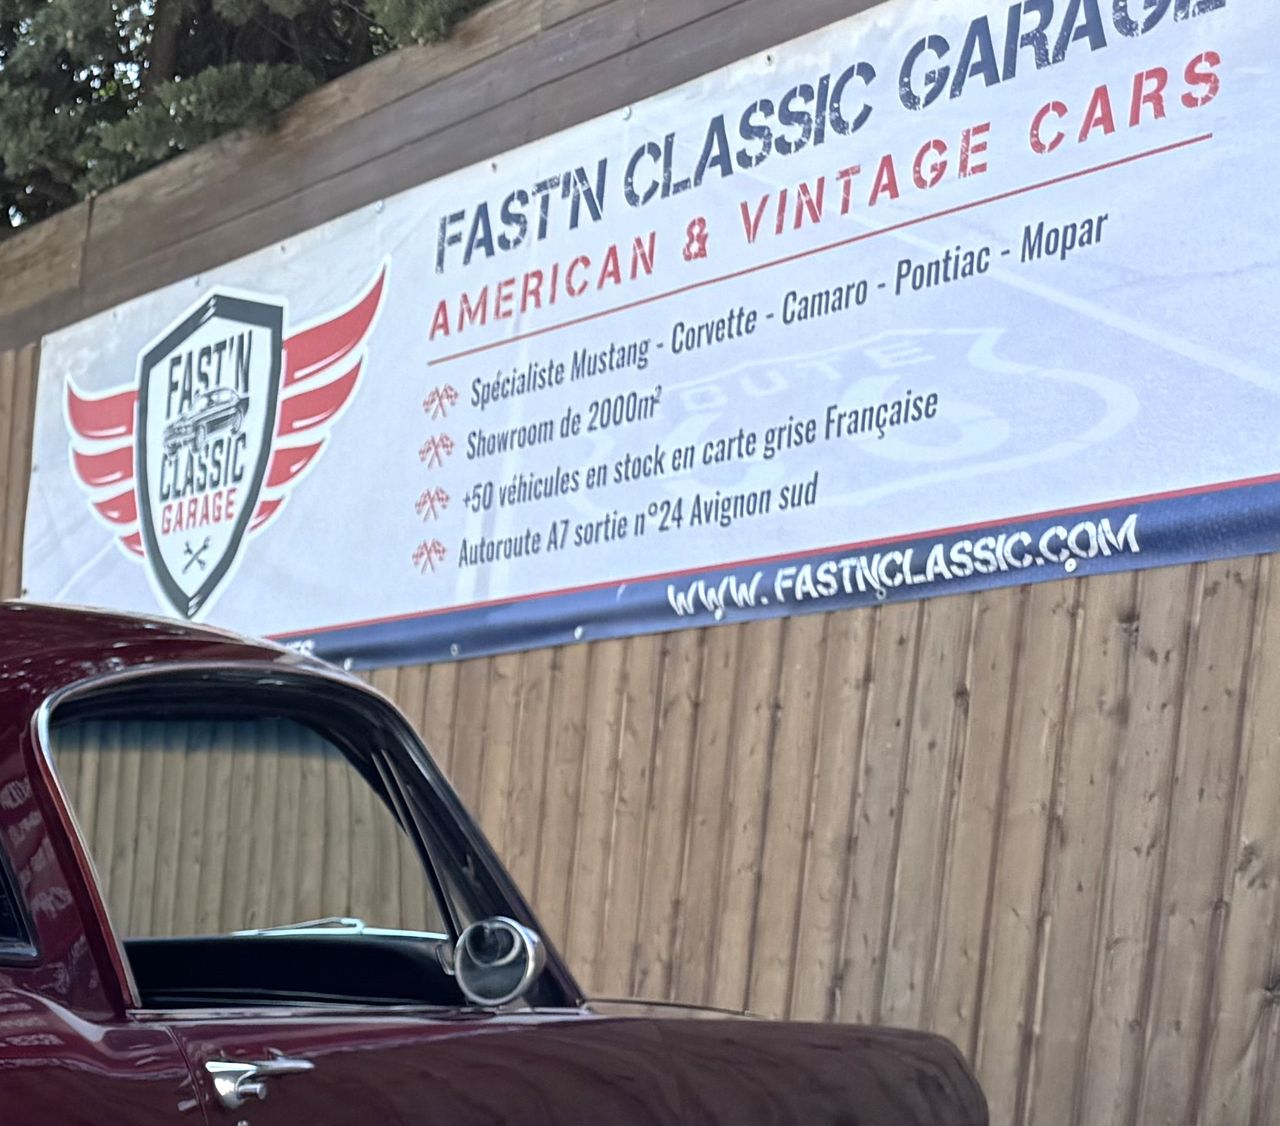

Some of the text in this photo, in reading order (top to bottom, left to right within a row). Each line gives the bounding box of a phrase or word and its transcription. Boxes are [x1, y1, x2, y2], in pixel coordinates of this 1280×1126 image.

[429, 51, 1221, 341] AMERICAN & VINTAGE CARS
[435, 157, 607, 274] FAST'N
[624, 62, 876, 207] CLASSIC
[471, 359, 565, 410] Spécialiste
[571, 338, 651, 382] Mustang
[671, 307, 758, 354] Corvette
[782, 278, 868, 325] Camaro
[877, 282, 886, 290] -
[895, 245, 991, 297] Pontiac
[1001, 248, 1011, 256] -
[1021, 213, 1109, 263] Mopar
[166, 329, 252, 420] FAST'N
[466, 385, 662, 460] Showroom de 2000m²
[160, 432, 247, 504] CLASSIC
[462, 389, 938, 513] +50 véhicules en stock en carte grise Française
[162, 488, 237, 534] GARAGE
[458, 471, 819, 567] Autoroute A7 sortie n°24 Avignon sud
